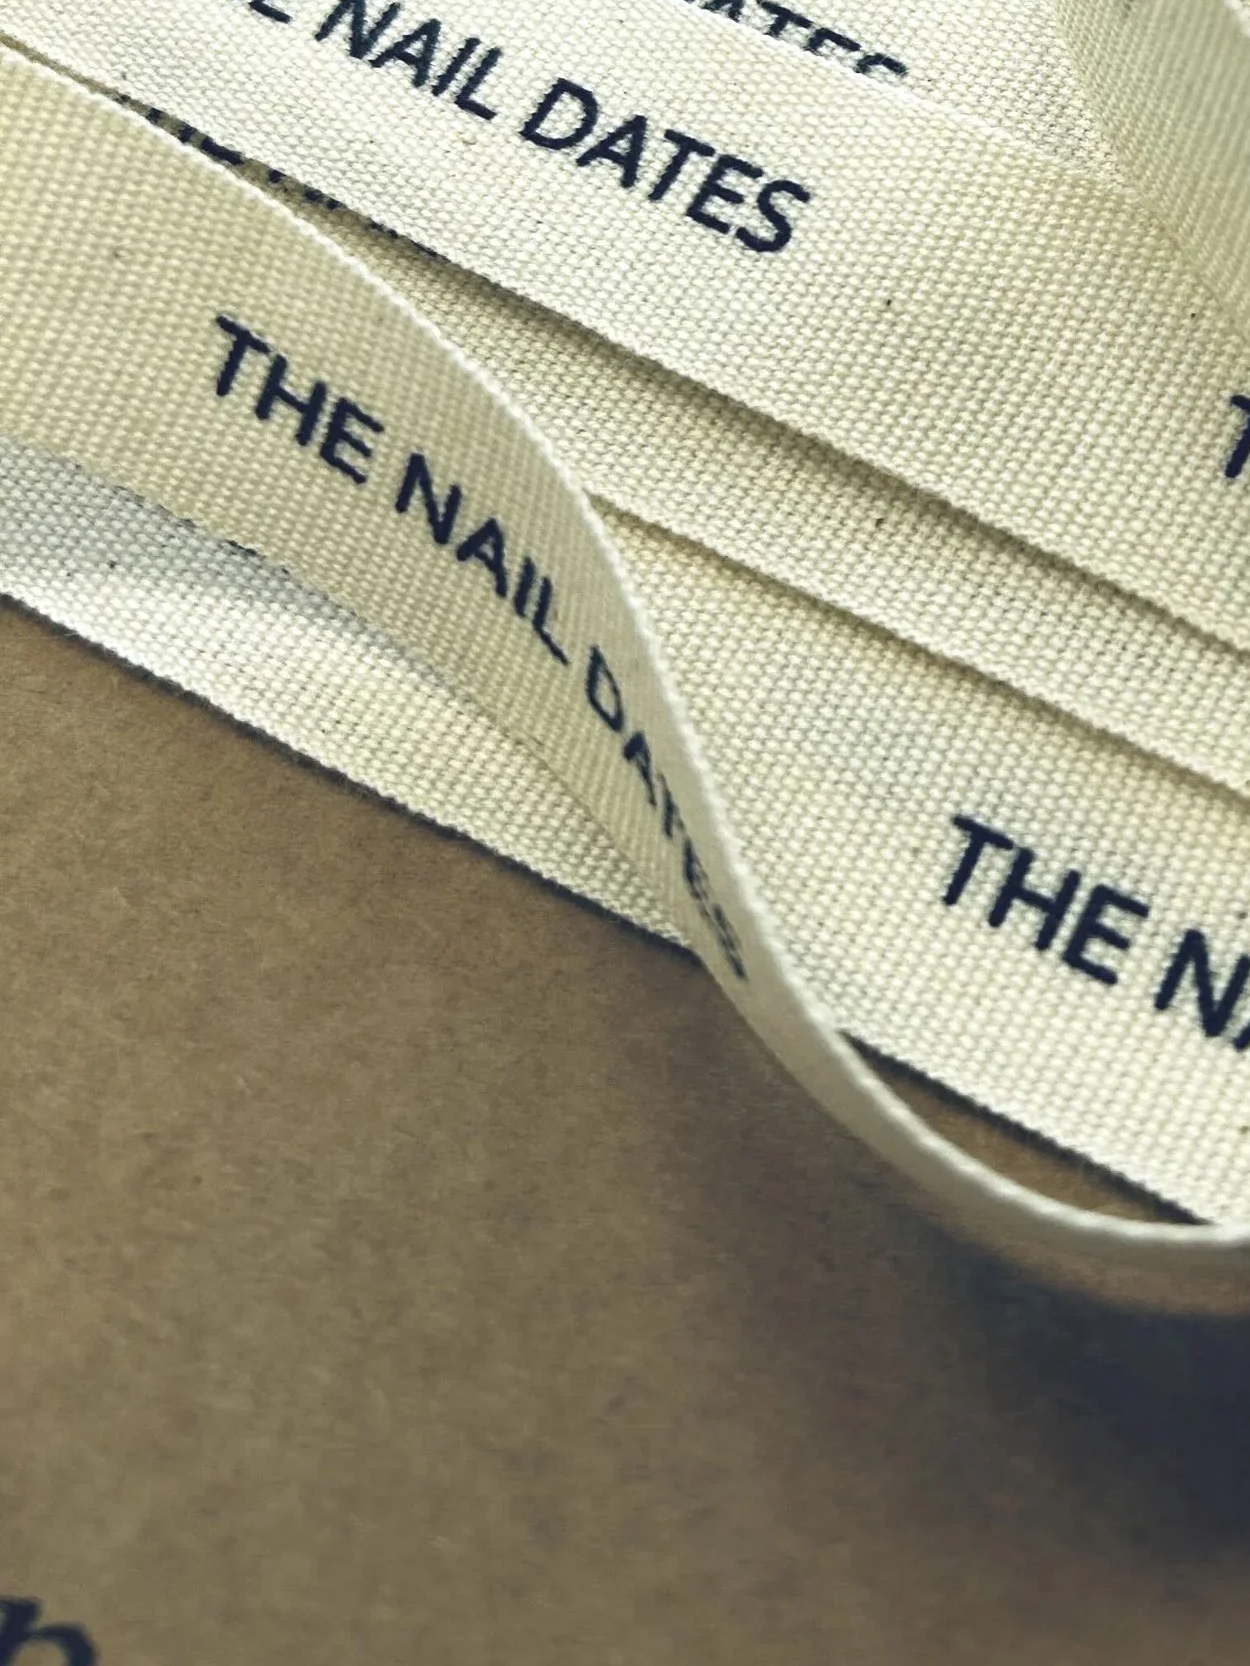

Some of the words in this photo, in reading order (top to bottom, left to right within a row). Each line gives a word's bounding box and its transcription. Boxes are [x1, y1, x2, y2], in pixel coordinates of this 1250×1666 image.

[517, 77, 812, 254] DATES
[214, 313, 385, 485] THE
[395, 452, 569, 666] NAIL
[940, 813, 1150, 986] THE
